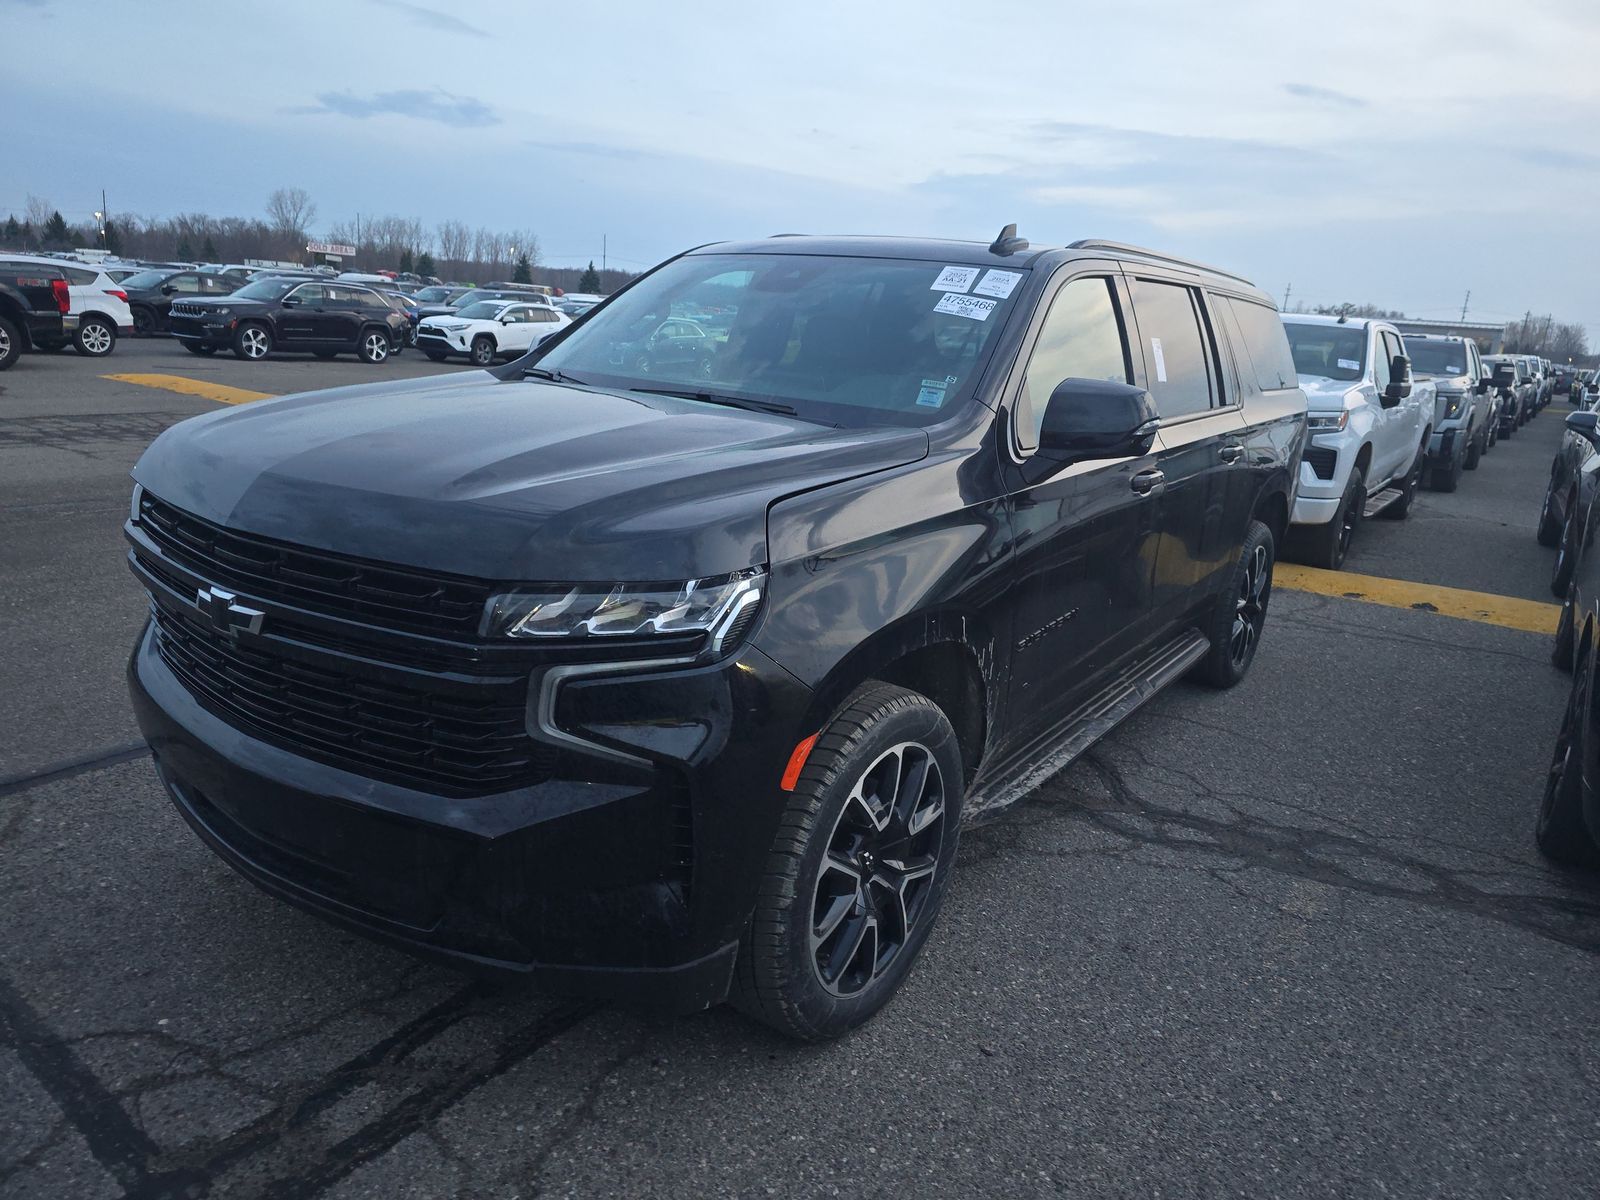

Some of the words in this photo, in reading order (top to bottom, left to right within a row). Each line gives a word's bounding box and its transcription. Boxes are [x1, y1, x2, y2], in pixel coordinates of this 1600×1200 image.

[309, 243, 327, 251] SOLD
[330, 246, 348, 254] AREA
[943, 295, 995, 311] 4755468
